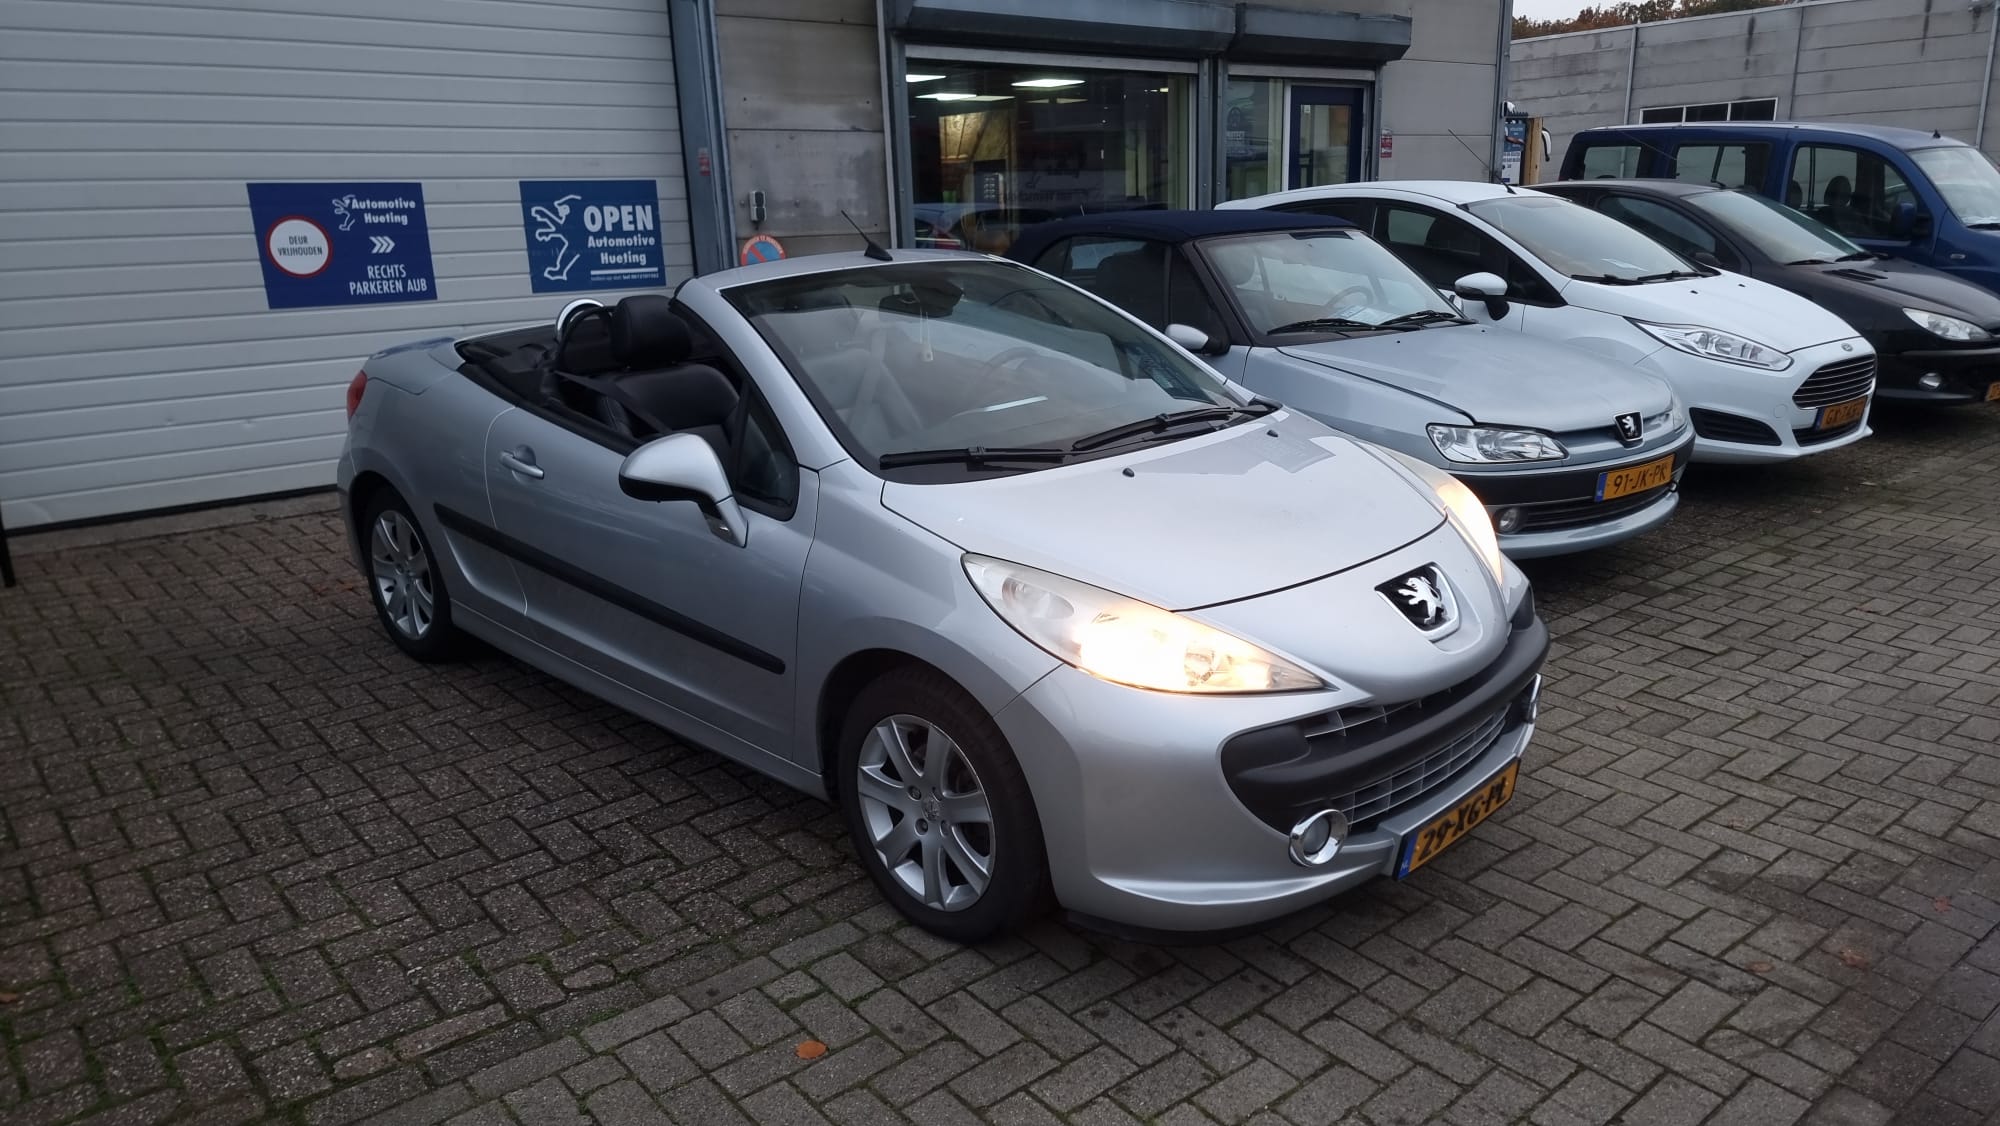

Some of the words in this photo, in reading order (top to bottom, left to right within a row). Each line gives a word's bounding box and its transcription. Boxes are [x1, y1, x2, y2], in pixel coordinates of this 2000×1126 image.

[351, 197, 416, 210] Automotive
[363, 212, 408, 226] Hueting
[583, 205, 654, 232] OPEN
[288, 235, 308, 245] DEUR
[587, 233, 656, 248] Automotive
[277, 246, 323, 256] VRIJHOUDEN
[600, 250, 647, 266] Hueting
[367, 264, 407, 279] RECHTS
[350, 280, 404, 295] PARKEREN
[407, 278, 428, 292] AUB
[1613, 462, 1668, 495] 91-JK-PK
